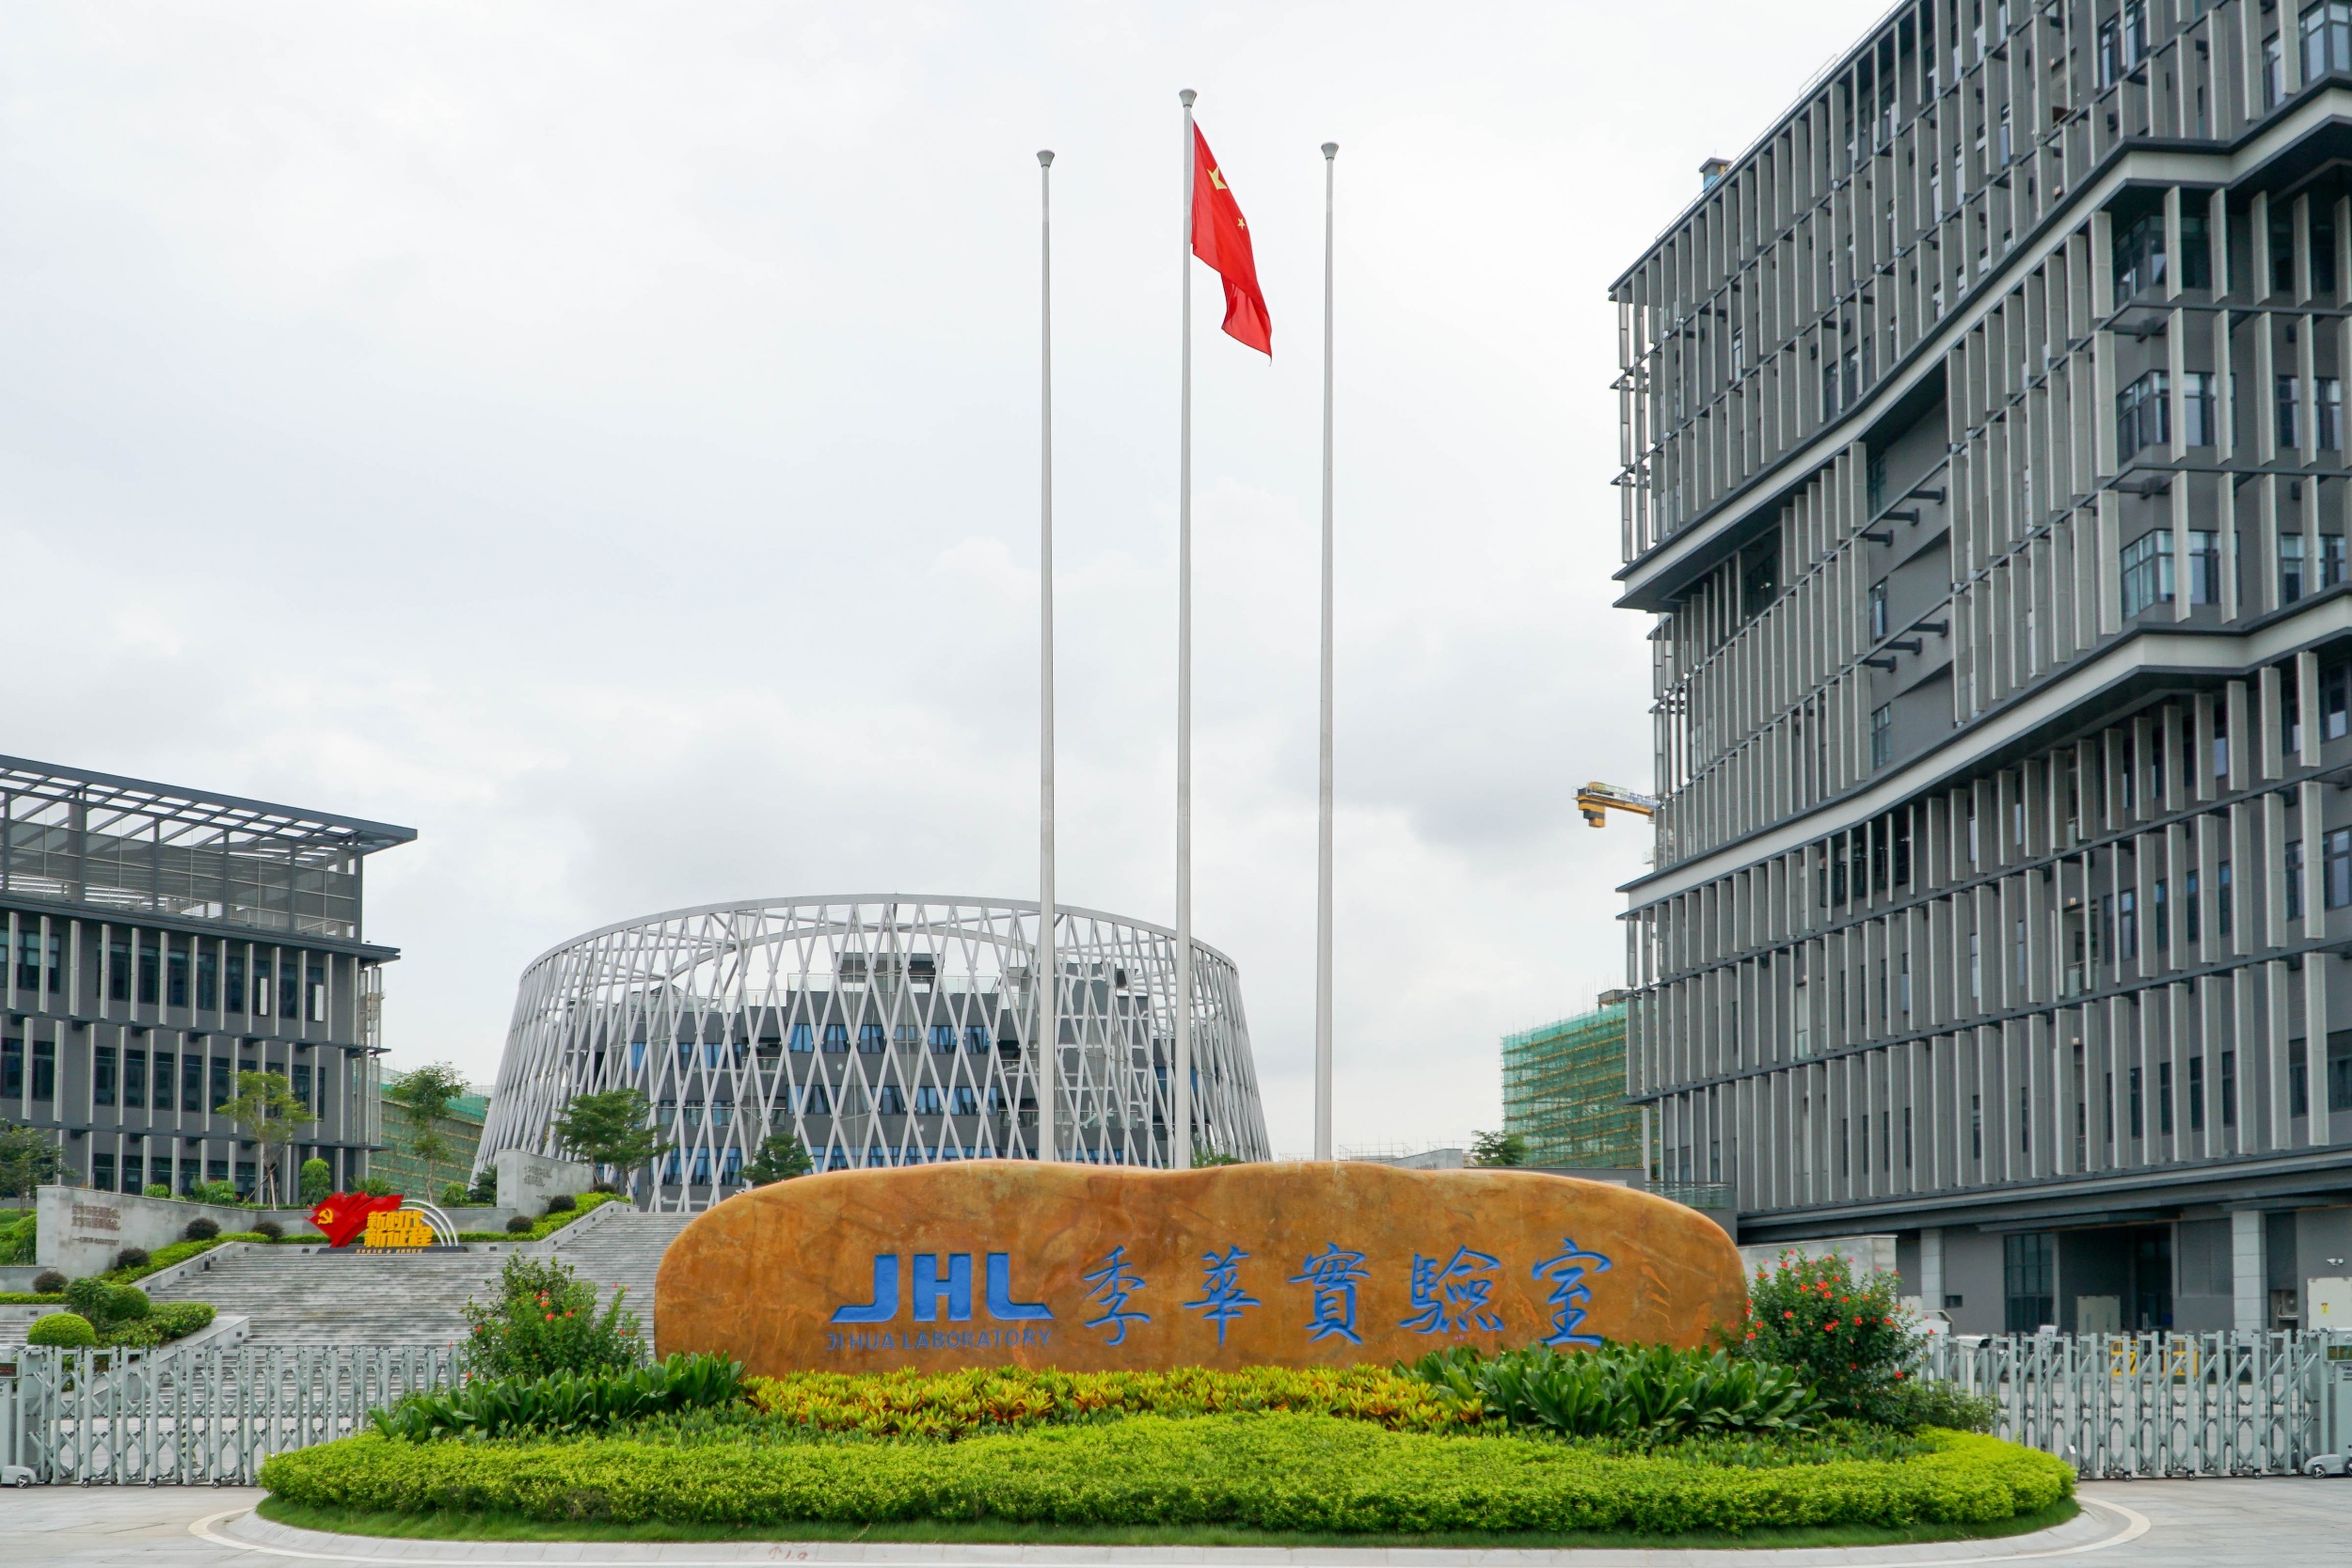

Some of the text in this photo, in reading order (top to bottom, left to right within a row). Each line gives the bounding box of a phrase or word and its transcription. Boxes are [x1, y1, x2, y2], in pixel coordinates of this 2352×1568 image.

[367, 1211, 424, 1228] 新时代
[364, 1227, 433, 1247] 新征程
[830, 1253, 1055, 1323] JHL
[1084, 1238, 1613, 1347] 季華實驗室
[850, 1332, 895, 1350] HUA
[902, 1328, 1052, 1350] LABORATORY
